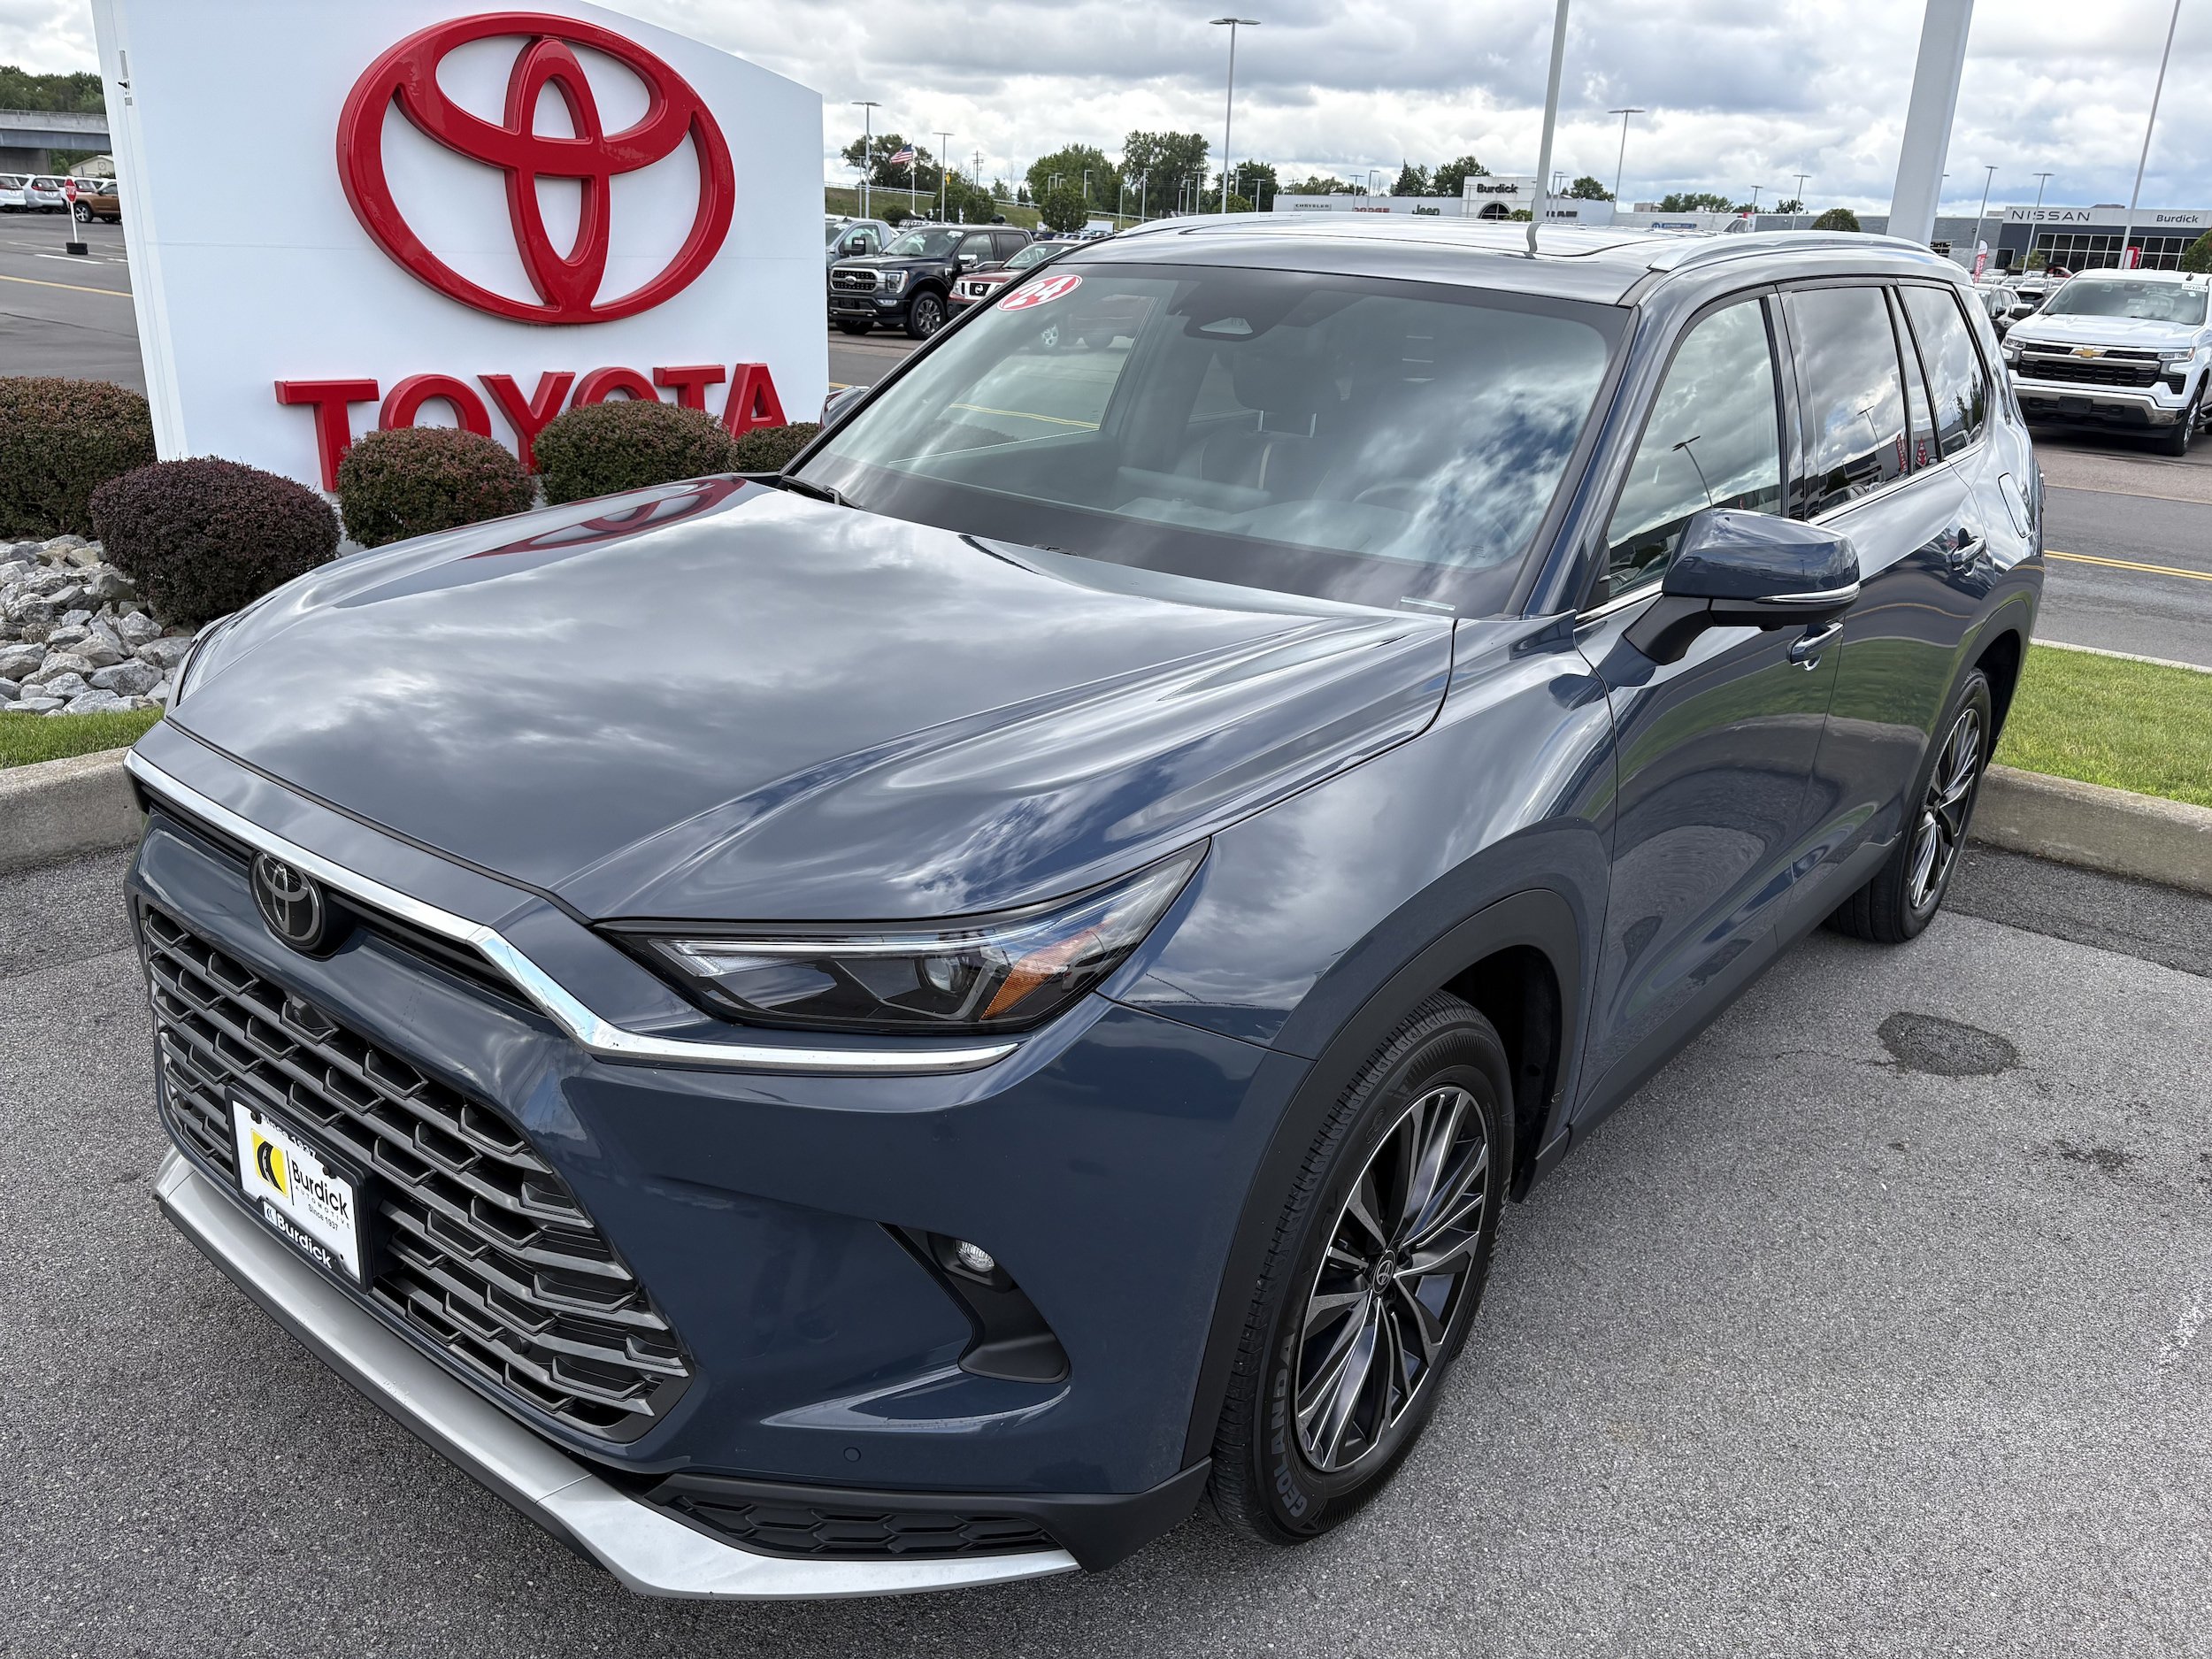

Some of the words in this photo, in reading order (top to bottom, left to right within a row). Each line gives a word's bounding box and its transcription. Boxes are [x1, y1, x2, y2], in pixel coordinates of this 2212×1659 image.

[1477, 183, 1518, 194] Burdick
[2011, 210, 2091, 221] NISSAN
[2156, 214, 2199, 224] Burdick
[1002, 275, 1077, 309] 24
[291, 1159, 349, 1220] Burdick
[295, 1185, 350, 1230] AUTOMOTIVE
[308, 1203, 325, 1221] Since
[277, 1213, 333, 1270] Burdick
[1271, 1305, 1309, 1519] GEOLANDA
